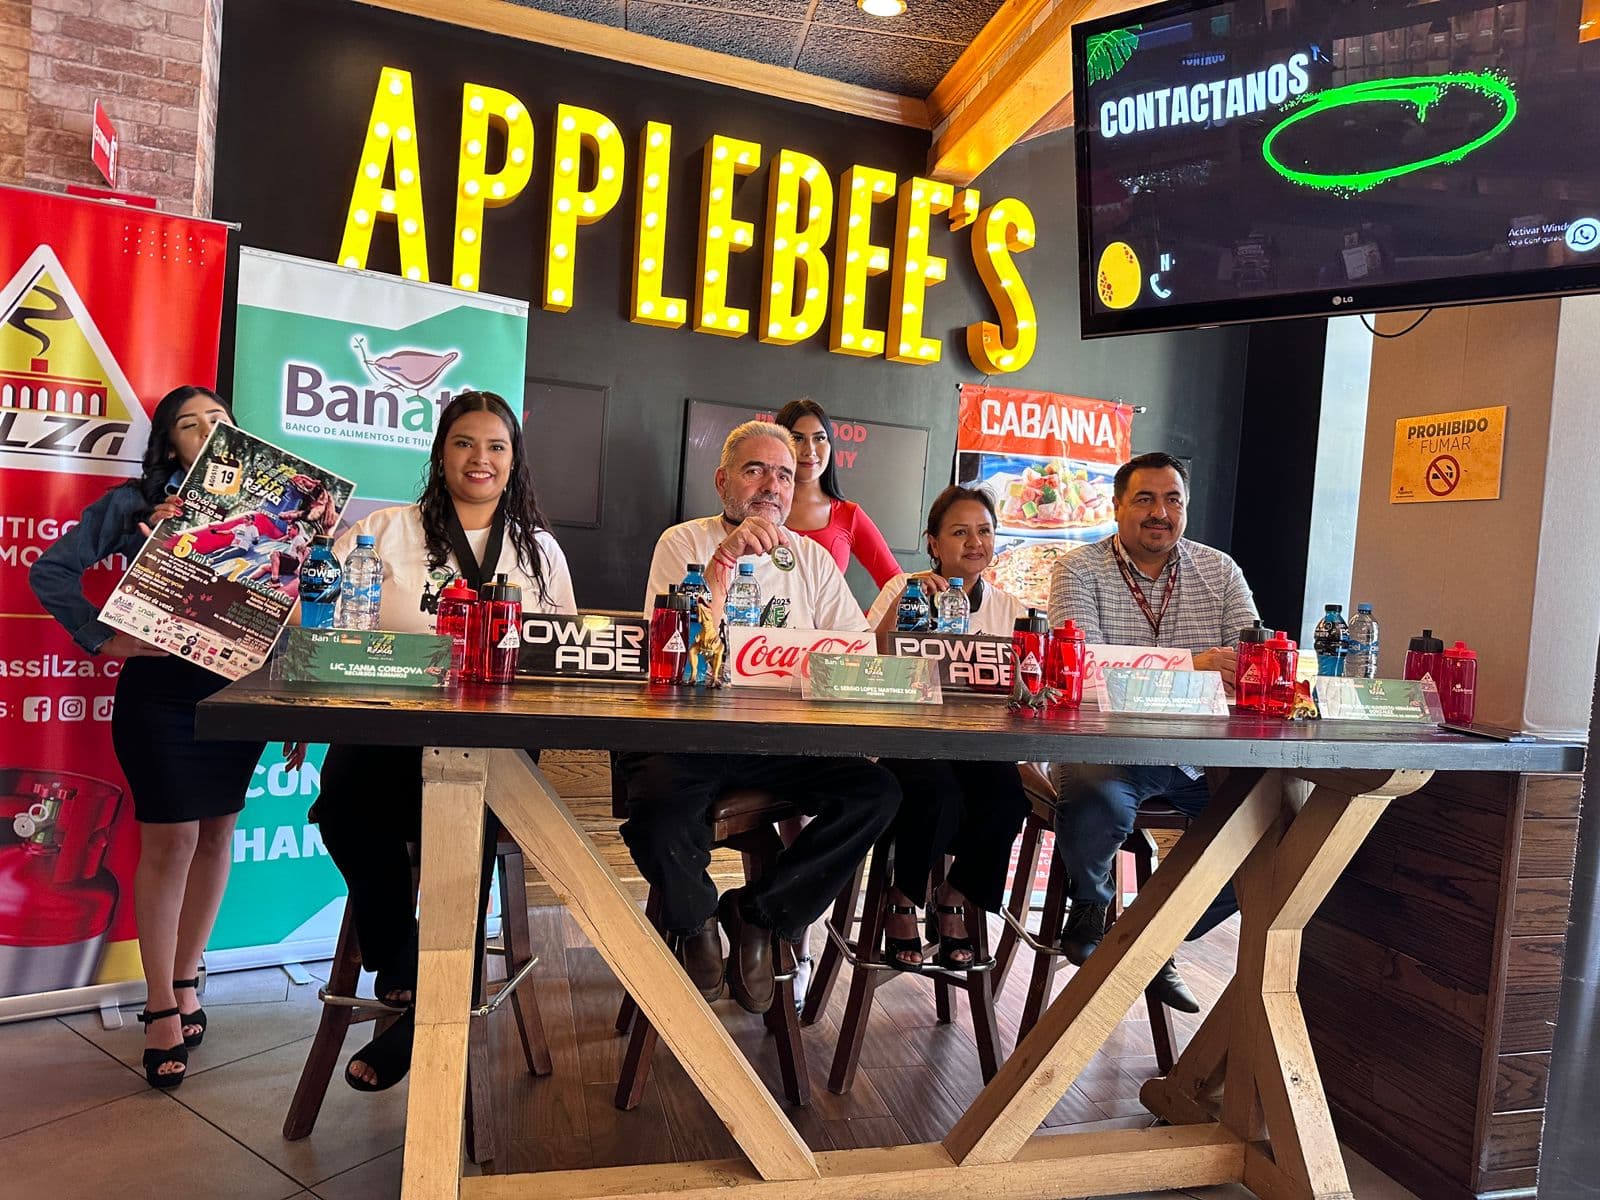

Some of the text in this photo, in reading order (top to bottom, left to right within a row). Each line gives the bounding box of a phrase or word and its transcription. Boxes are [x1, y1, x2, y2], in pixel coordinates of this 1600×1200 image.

[1100, 53, 1309, 138] CONTACTANOS
[338, 66, 1037, 375] APPLEBEE'S
[1508, 226, 1540, 237] Activar
[285, 363, 471, 434] Banat
[285, 421, 320, 433] BANCO
[323, 426, 337, 436] DE
[339, 428, 395, 443] ALIMENTOS
[397, 436, 411, 445] DE
[981, 399, 1115, 448] CABANNA
[1407, 417, 1489, 440] PROHIBIDO
[1420, 435, 1471, 454] FUMAR
[220, 470, 234, 484] 19
[0, 516, 80, 540] TIG
[173, 532, 198, 558] 5
[311, 633, 340, 643] Banti
[0, 654, 125, 678] ssilza.c
[329, 662, 423, 675] LIC. TANIA CORDOVA
[555, 646, 640, 672] ADE
